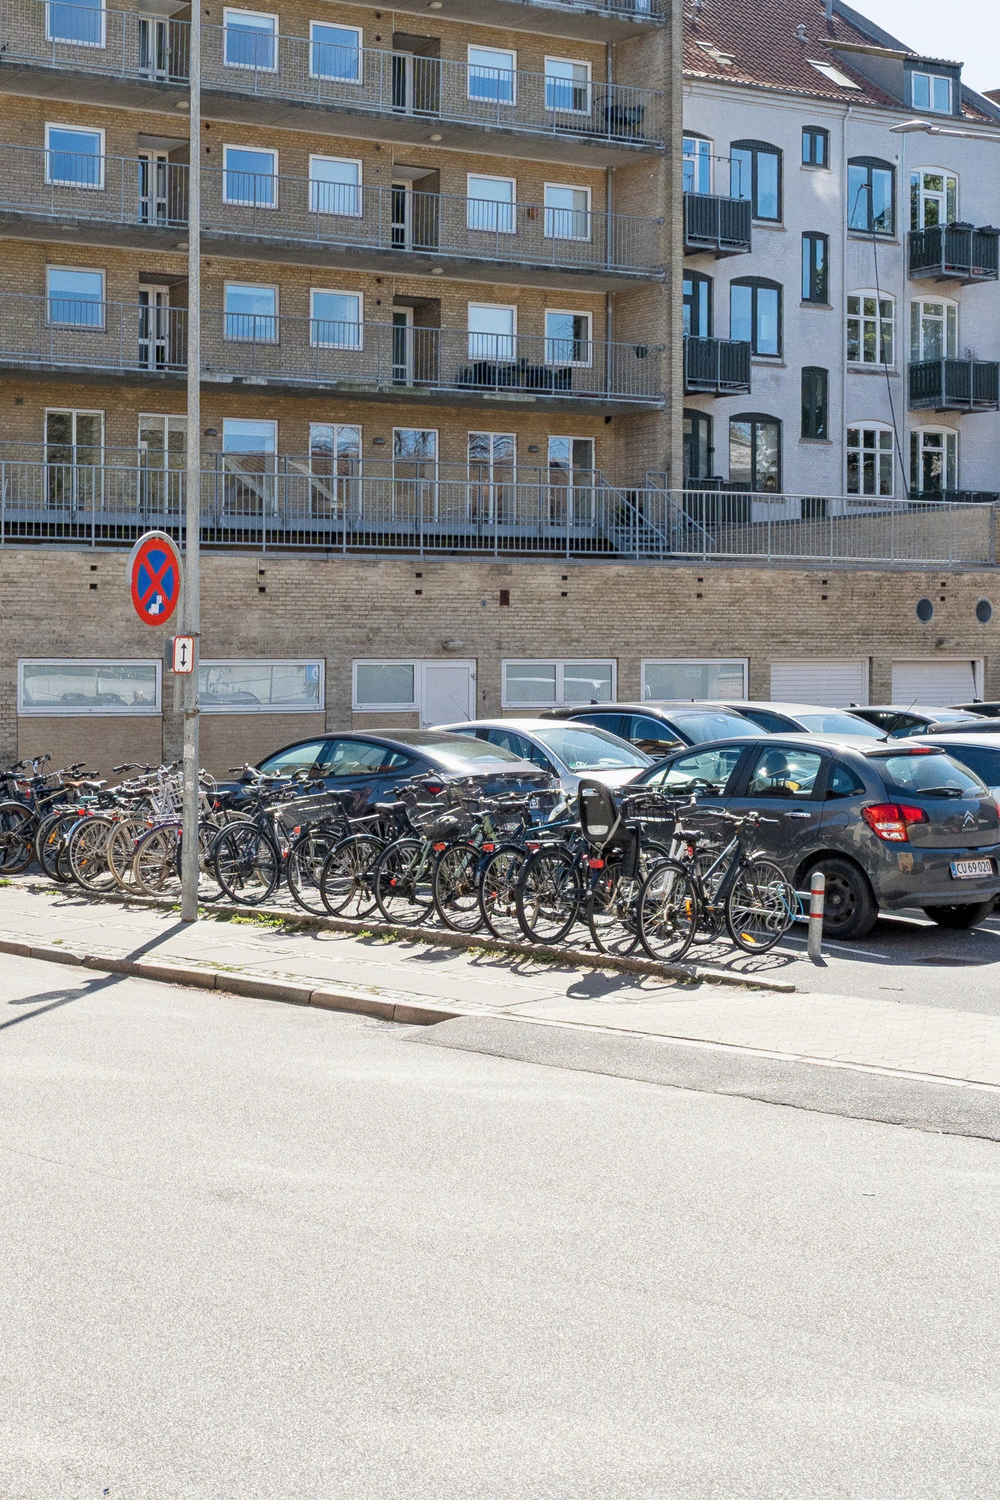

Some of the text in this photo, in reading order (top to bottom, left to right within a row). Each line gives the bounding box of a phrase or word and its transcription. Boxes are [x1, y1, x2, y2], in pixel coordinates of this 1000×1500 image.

[957, 861, 991, 874] CU 69 020
